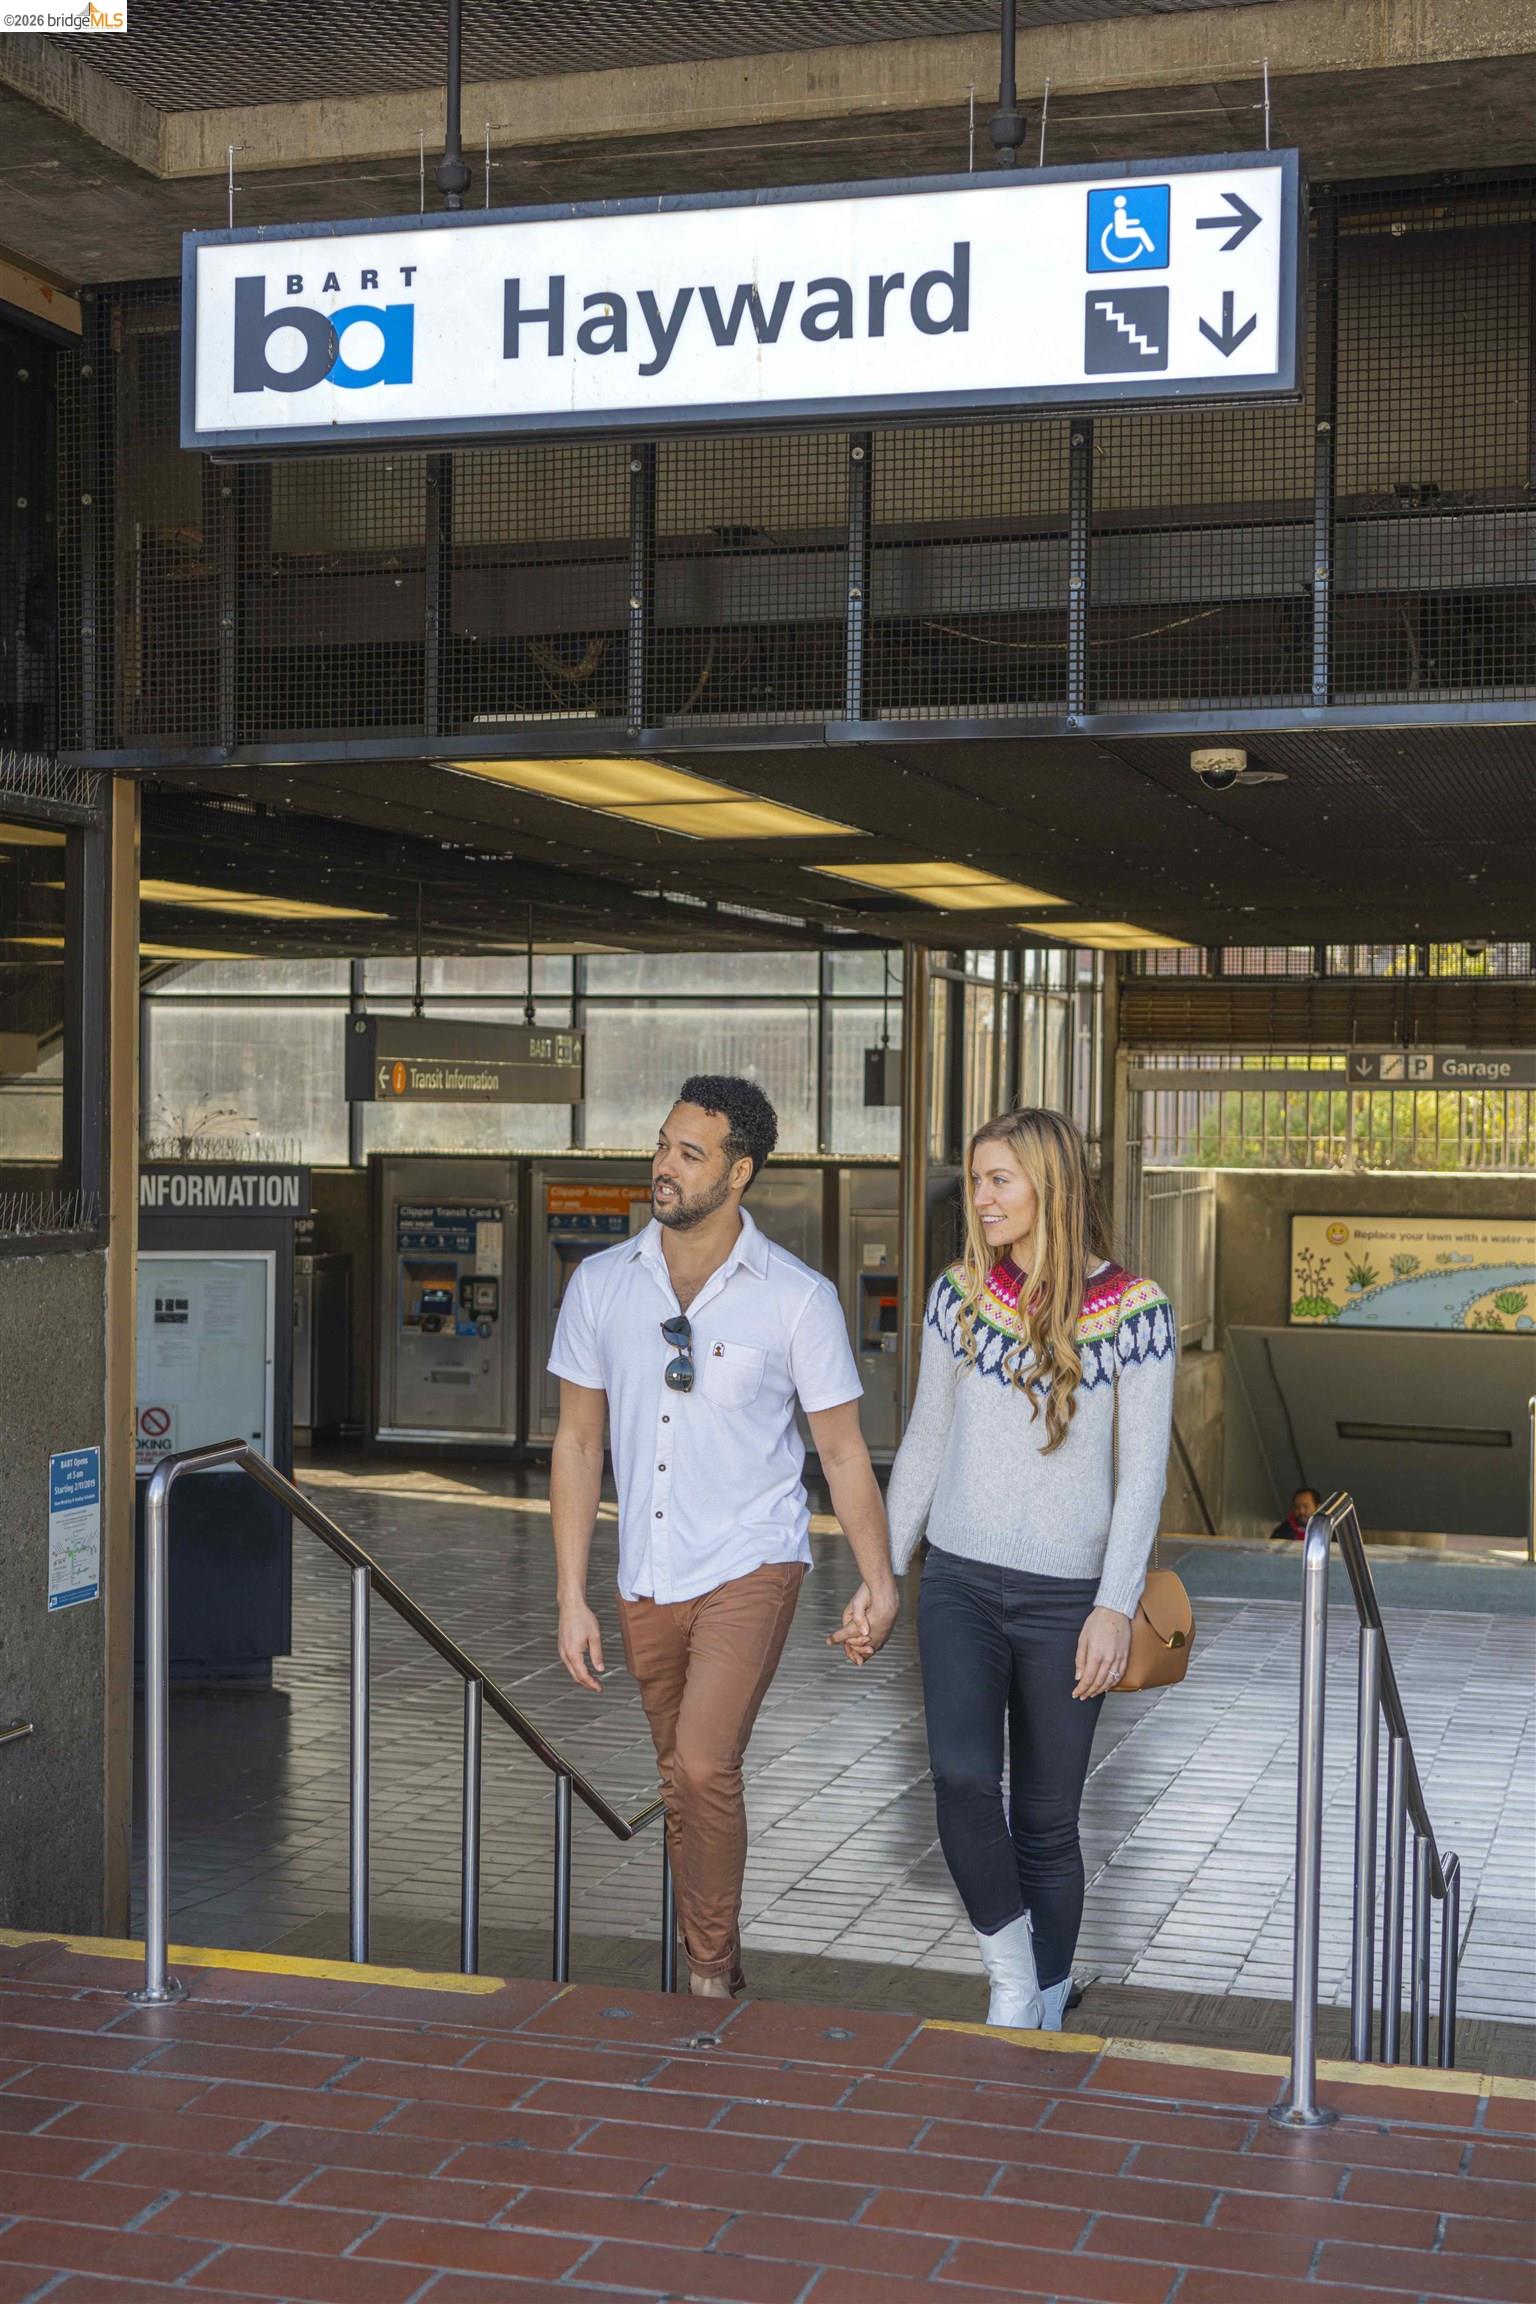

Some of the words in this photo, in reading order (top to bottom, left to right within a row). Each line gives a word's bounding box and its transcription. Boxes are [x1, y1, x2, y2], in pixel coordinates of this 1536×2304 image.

[286, 266, 417, 295] BART
[502, 241, 971, 377] Hayward
[233, 275, 415, 393] ba
[1442, 1059, 1511, 1080] Garage
[410, 1067, 444, 1089] Transit
[445, 1067, 499, 1090] Information
[139, 1174, 300, 1206] NFORMATION
[550, 1186, 585, 1198] Clipper
[587, 1186, 620, 1197] Transit
[621, 1187, 645, 1198] Card
[400, 1207, 433, 1217] Clipper
[436, 1207, 467, 1217] Transit
[469, 1208, 492, 1217] Card
[1353, 1229, 1396, 1241] Replace
[1399, 1232, 1424, 1242] your
[1426, 1230, 1452, 1241] lawn
[1455, 1231, 1479, 1242] with
[1481, 1235, 1488, 1243] a
[135, 1438, 172, 1449] OKING
[60, 1459, 73, 1469] BART
[73, 1457, 88, 1468] Opens
[54, 1485, 74, 1495] Starting
